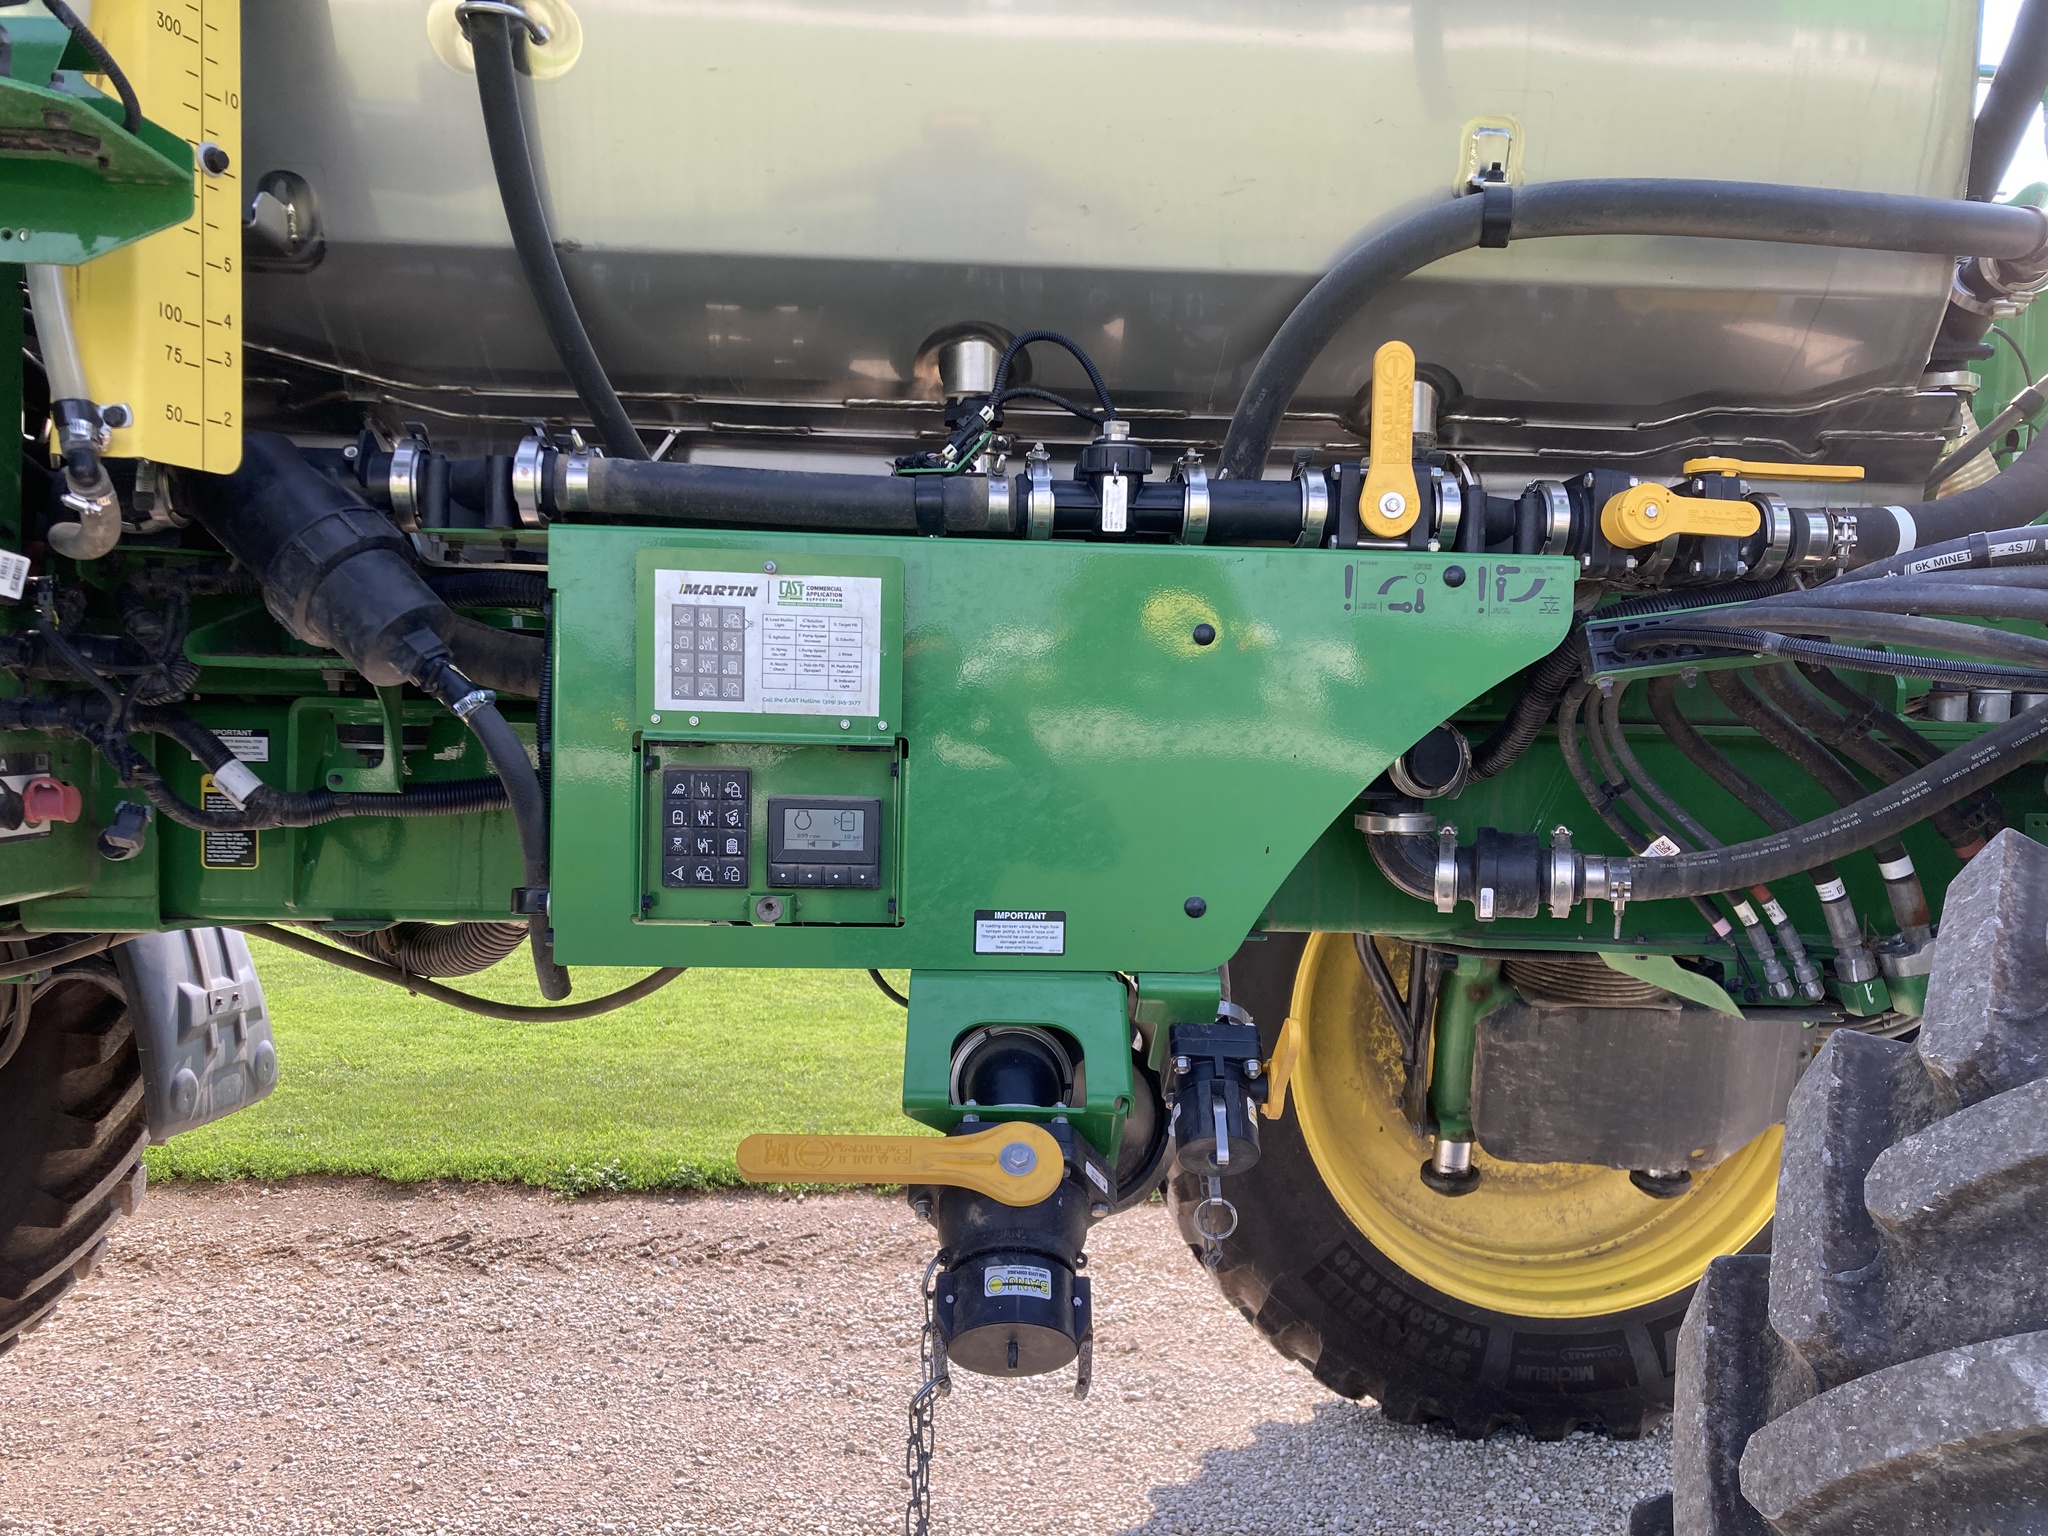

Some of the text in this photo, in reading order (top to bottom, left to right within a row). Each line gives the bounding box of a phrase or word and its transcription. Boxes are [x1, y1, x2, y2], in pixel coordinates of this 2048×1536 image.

[157, 10, 181, 36] 300
[225, 90, 239, 110] 10
[224, 257, 232, 273] 5
[159, 301, 183, 323] 100
[224, 314, 232, 330] 4
[165, 344, 183, 364] 75
[224, 351, 232, 368] 3
[166, 404, 183, 423] 50
[224, 411, 232, 428] 2
[2008, 543, 2023, 552] 4S
[1915, 561, 1930, 571] 6K
[683, 583, 759, 597] MARTIN
[779, 580, 805, 599] CAST
[994, 912, 1047, 920] IMPORTANT
[986, 1275, 1049, 1295] BANJO
[1452, 1327, 1482, 1348] VF
[1515, 1364, 1595, 1381] MICHELIN
